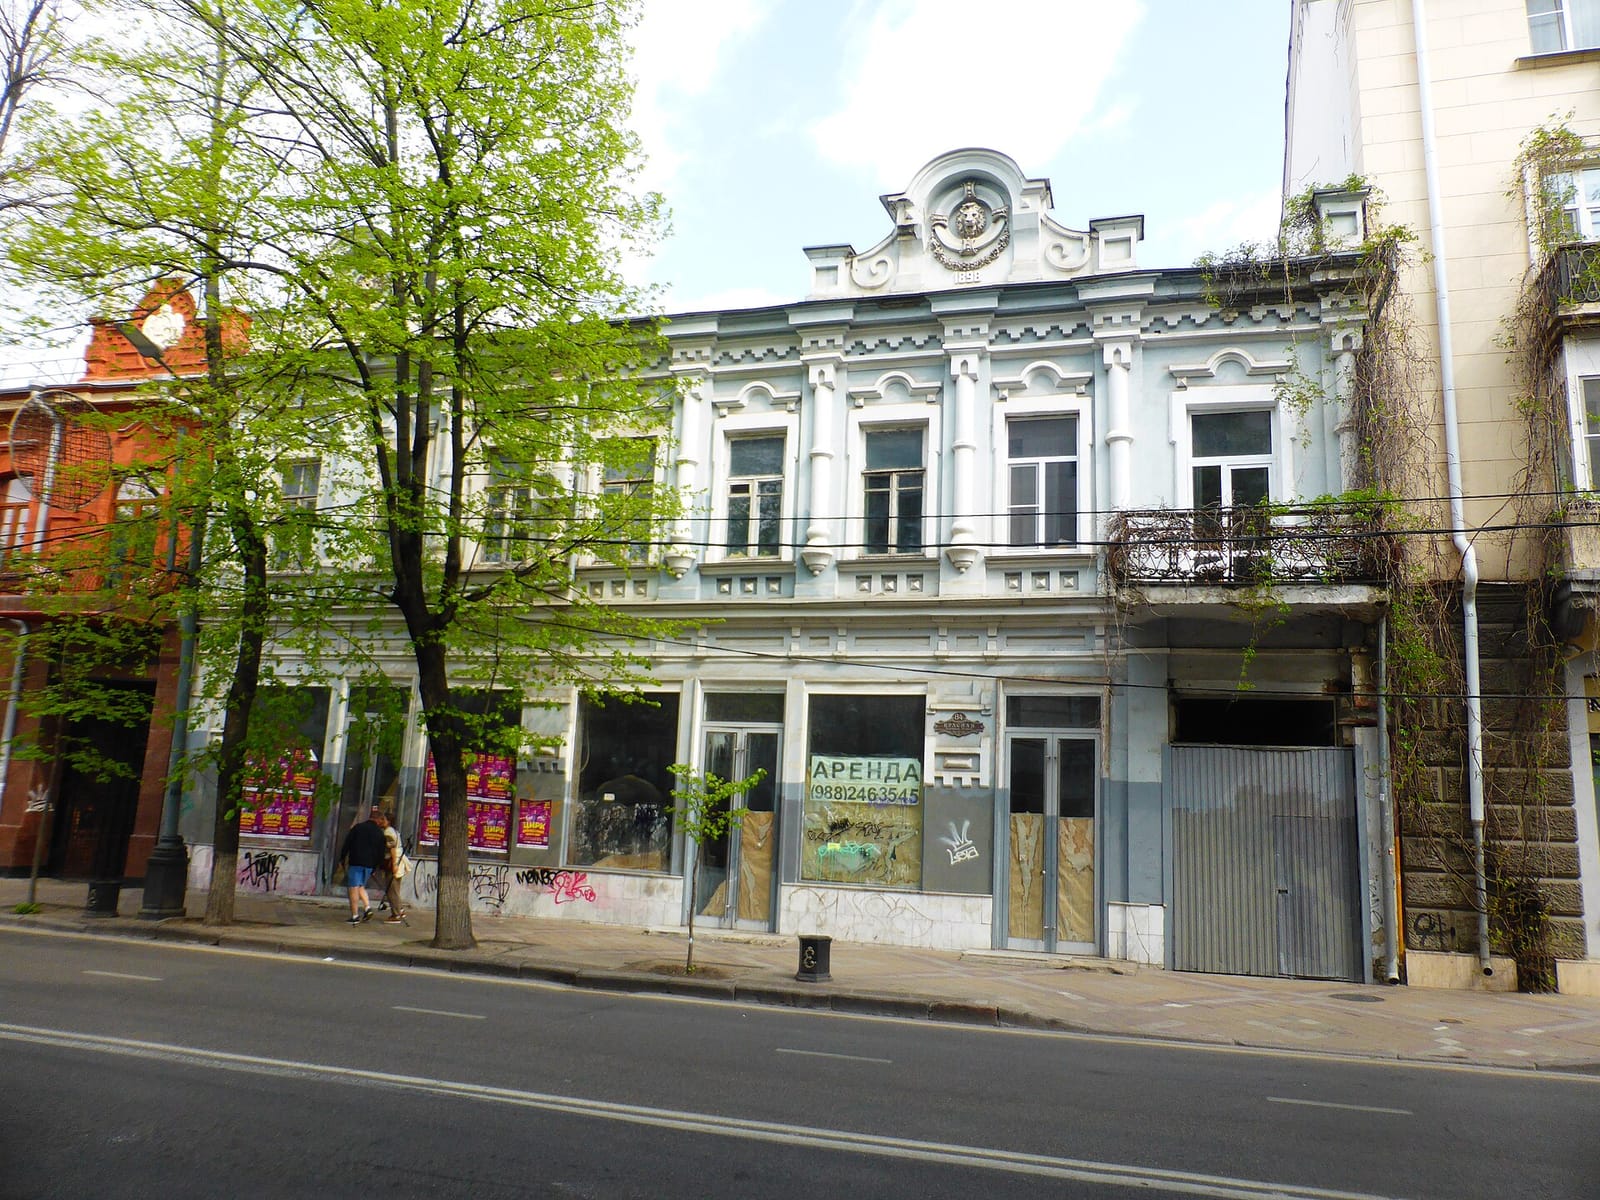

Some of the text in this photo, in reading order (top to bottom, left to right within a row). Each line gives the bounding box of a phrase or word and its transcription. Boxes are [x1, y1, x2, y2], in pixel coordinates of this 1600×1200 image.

[954, 270, 981, 284] 1898
[812, 761, 920, 783] АРЕНДА
[811, 784, 919, 804] (988)2463545
[523, 821, 546, 830] ЦИРК
